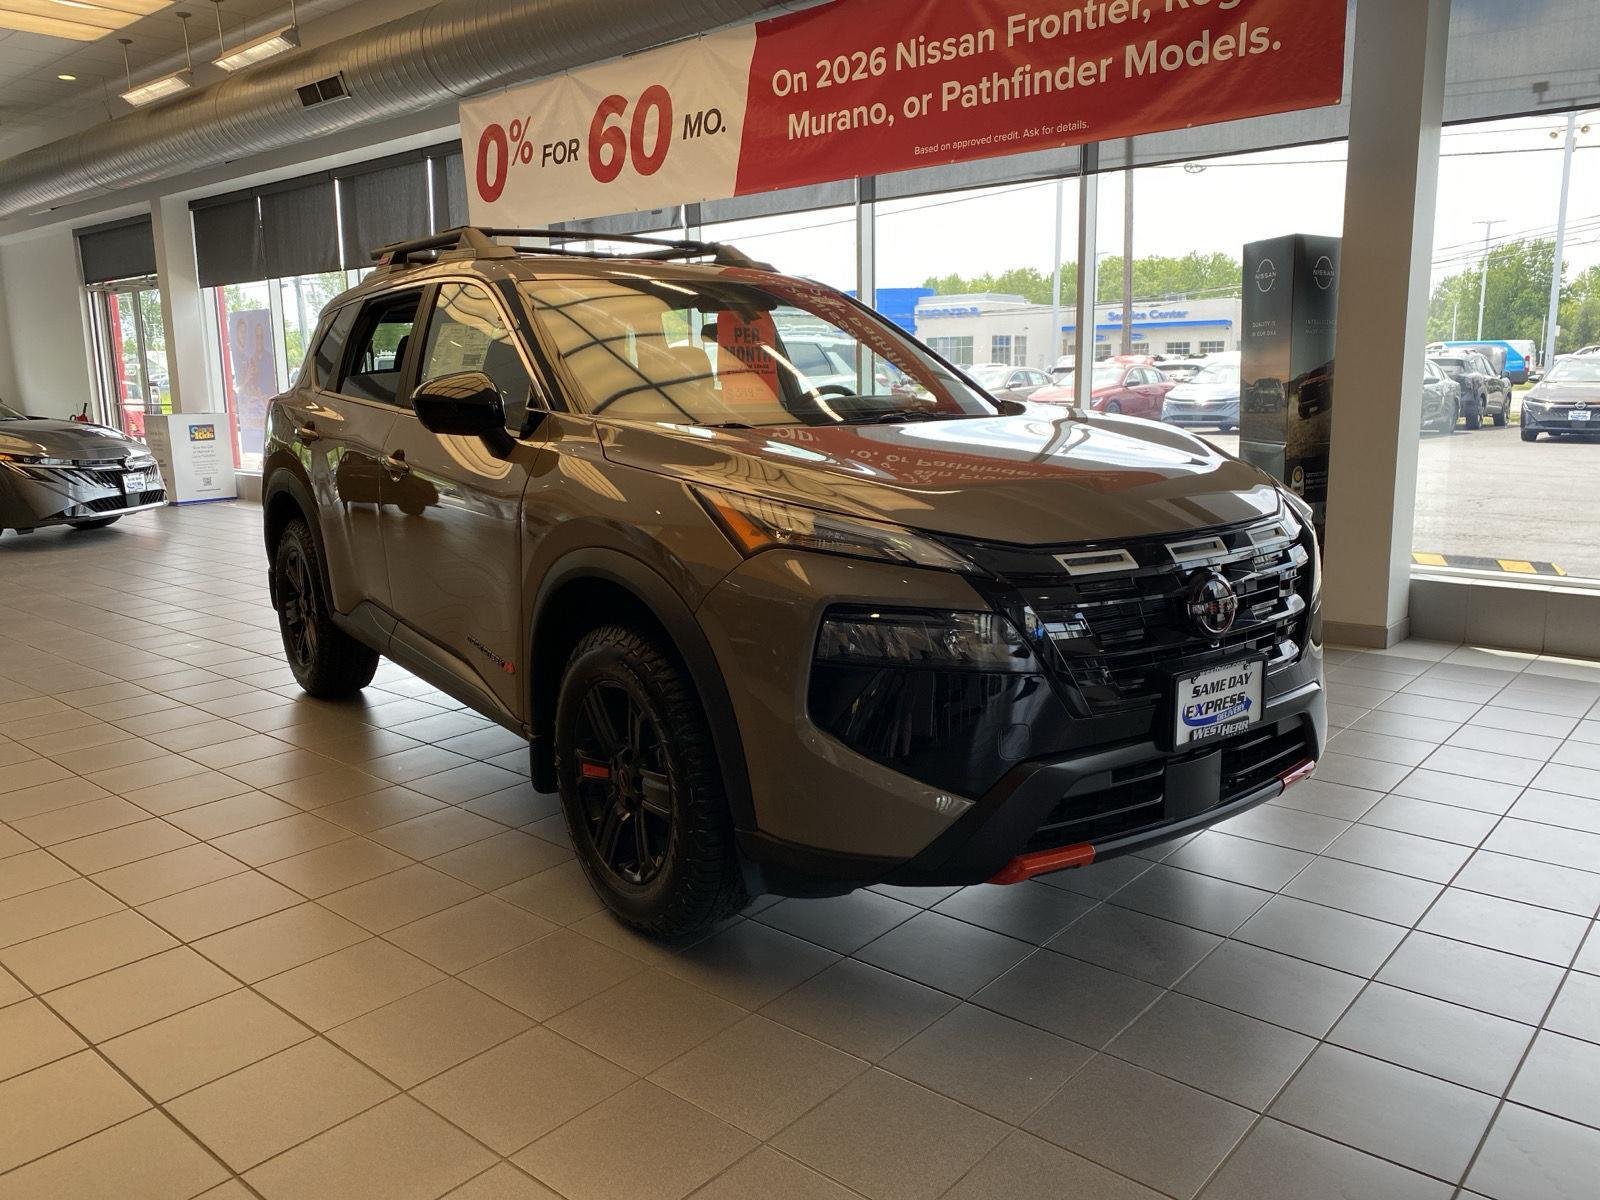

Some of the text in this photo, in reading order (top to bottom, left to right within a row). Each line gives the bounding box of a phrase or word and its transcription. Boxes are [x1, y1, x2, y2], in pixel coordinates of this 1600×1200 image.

[772, 0, 1151, 97] On 2026 Nissan Frontier,
[788, 22, 1282, 140] Murano, or Pathfinder Models.
[476, 84, 727, 203] 0% FOR 60 MO.
[914, 120, 1090, 156] Based on approved credit. Ask for details.
[1255, 271, 1277, 280] NISSAN
[1312, 269, 1335, 277] NISSAN
[1107, 309, 1189, 321] Serice Center
[734, 327, 760, 343] PER
[1191, 671, 1253, 698] SAME DAY
[1186, 691, 1246, 719] EXPRESS
[1216, 703, 1246, 722] DELIVERY
